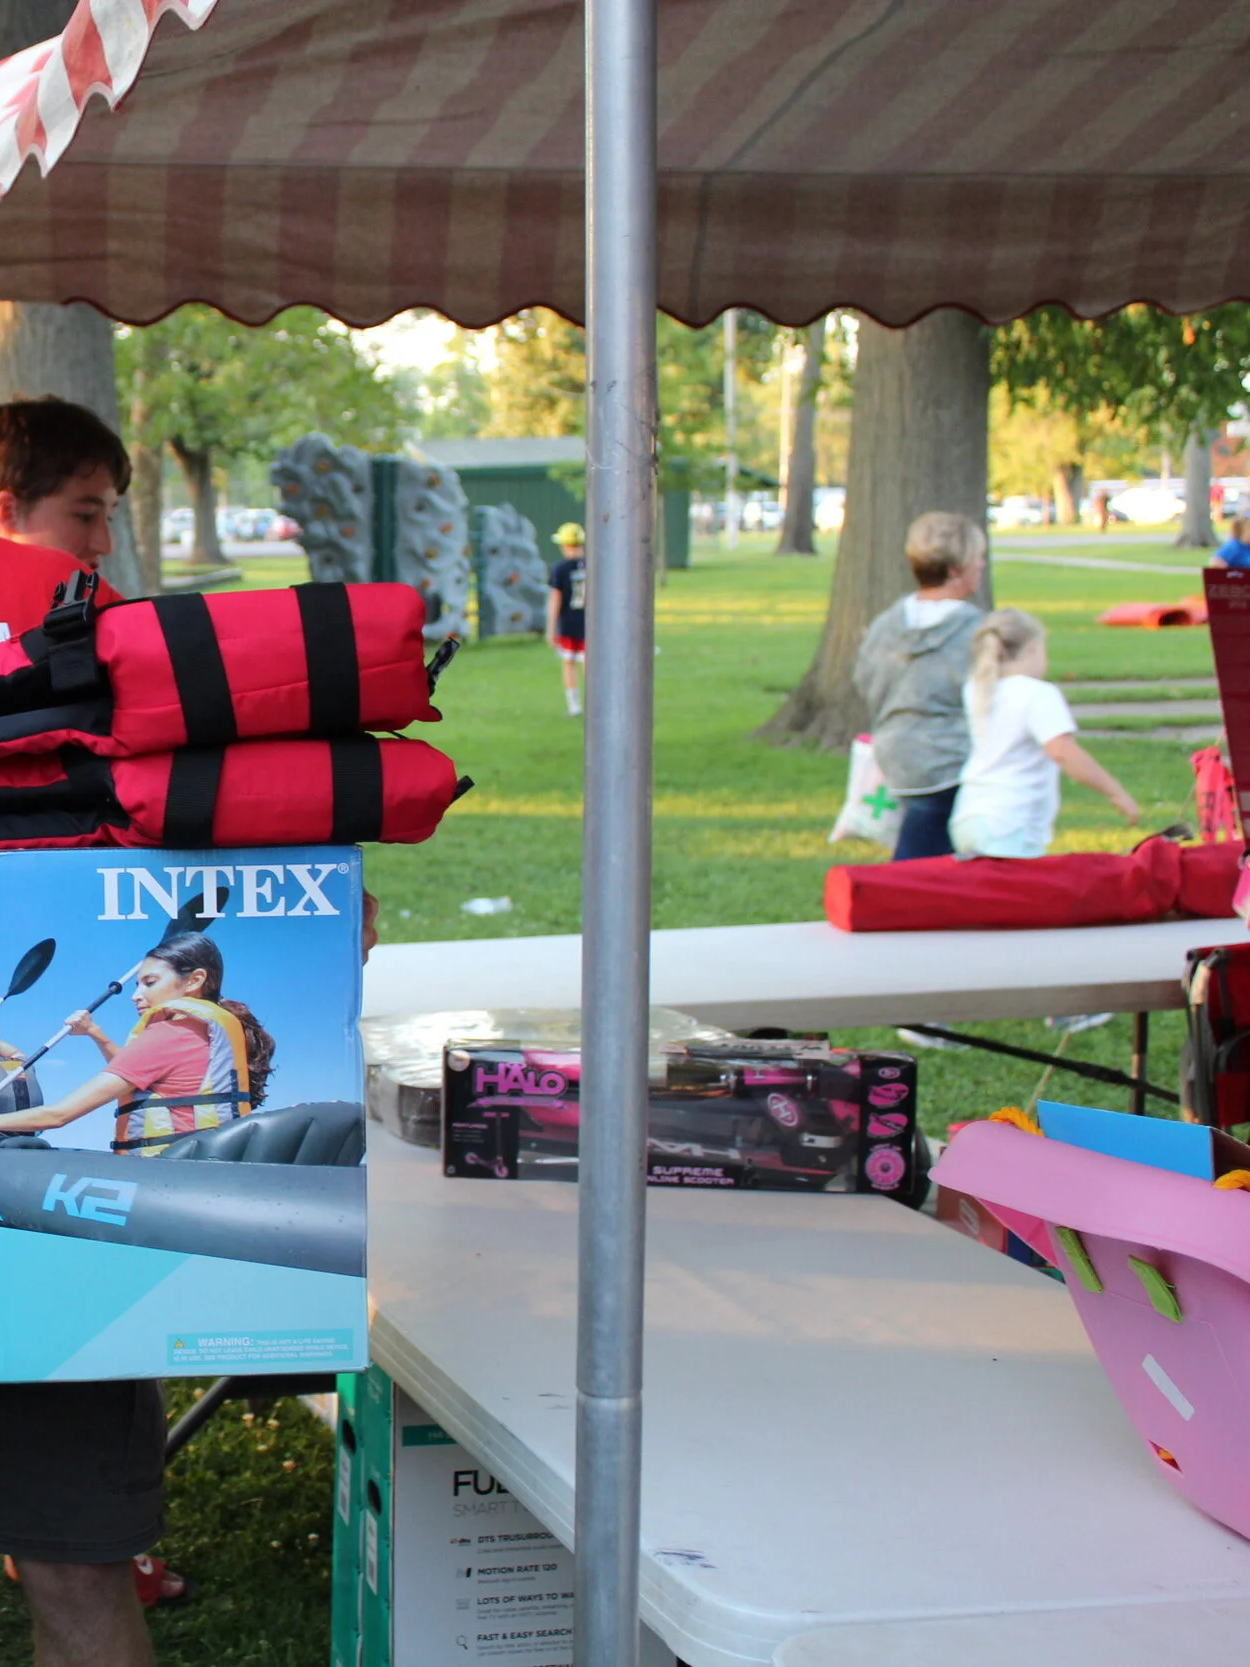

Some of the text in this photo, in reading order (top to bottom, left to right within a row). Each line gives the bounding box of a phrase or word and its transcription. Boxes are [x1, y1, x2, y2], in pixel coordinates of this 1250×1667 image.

[96, 863, 341, 921] INTEX
[475, 1062, 566, 1096] HALO
[682, 1176, 736, 1186] SCOOTER
[42, 1172, 139, 1227] K2
[452, 1500, 509, 1518] SMART
[477, 1563, 558, 1576] MOTION RATE 120
[477, 1596, 500, 1606] LOTS
[502, 1595, 516, 1603] OF
[517, 1593, 544, 1602] WAYS
[546, 1592, 559, 1600] TO
[477, 1633, 500, 1642] FAST
[510, 1630, 535, 1640] EASY
[536, 1628, 574, 1638] SEARCH
